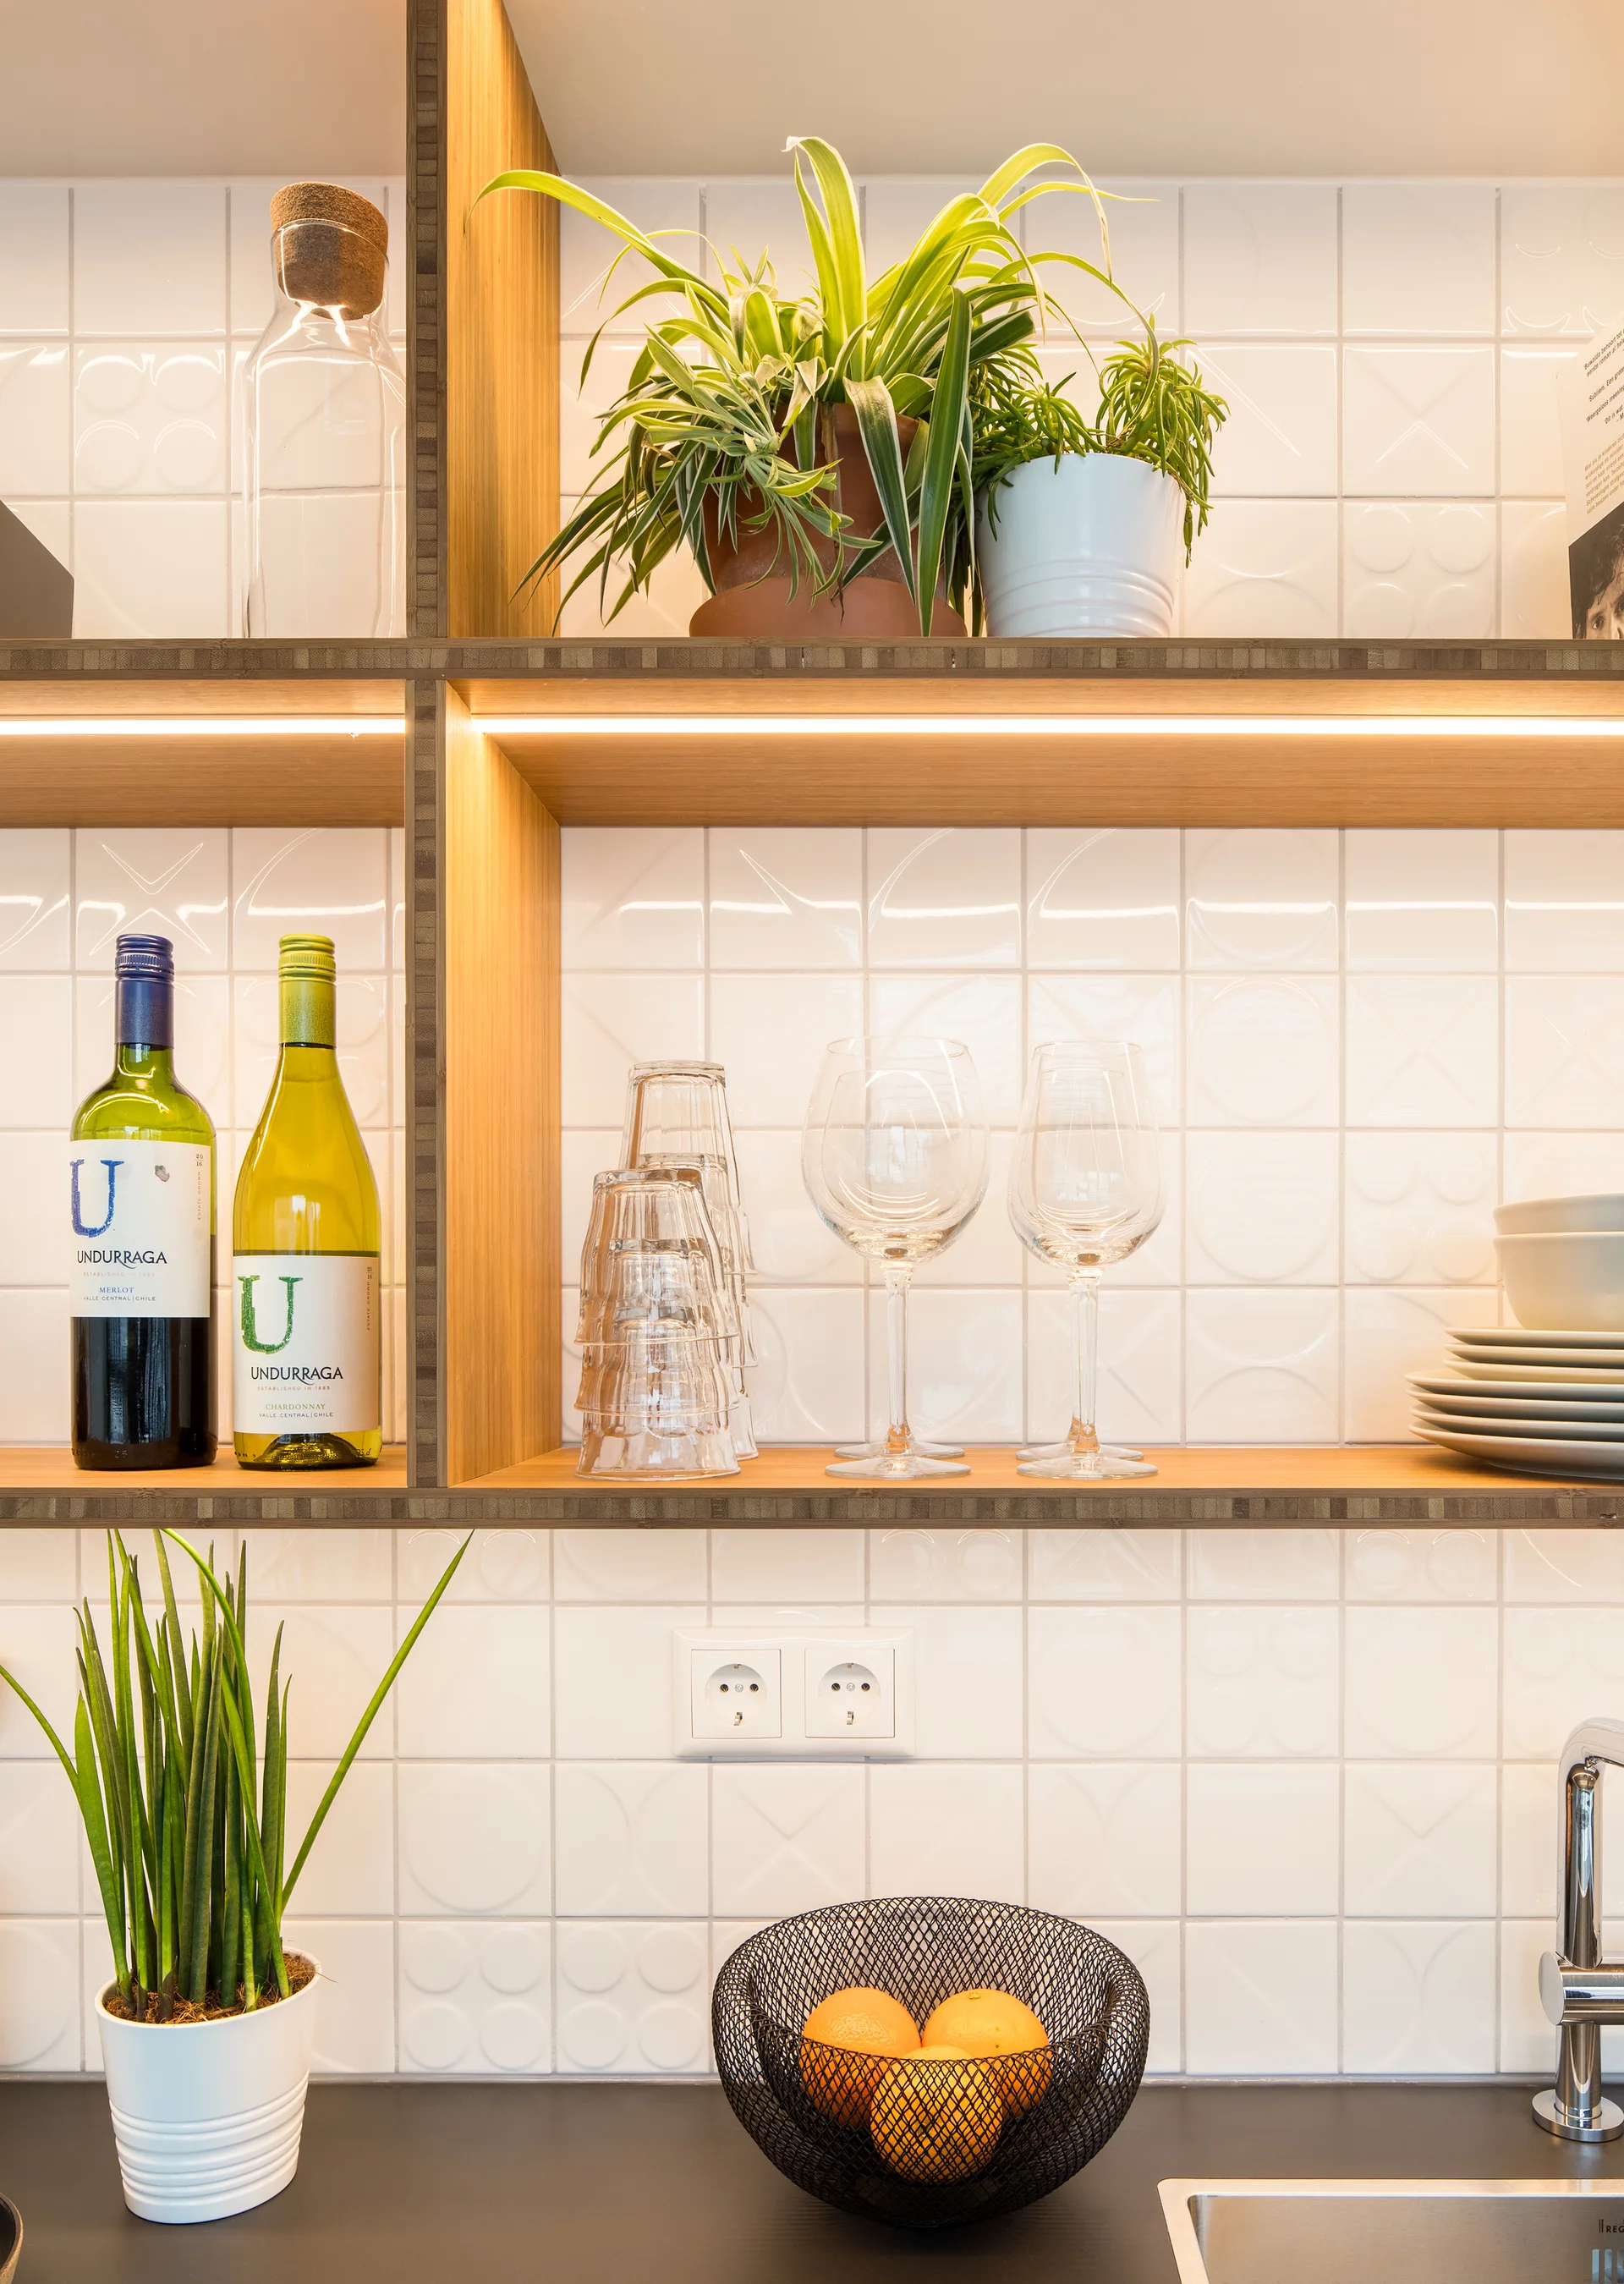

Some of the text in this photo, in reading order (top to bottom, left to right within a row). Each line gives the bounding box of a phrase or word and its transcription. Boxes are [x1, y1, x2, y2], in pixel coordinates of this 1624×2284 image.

[69, 1159, 125, 1238] U
[77, 1249, 167, 1270] UNDURRAGA
[238, 1275, 303, 1355] U
[250, 1366, 343, 1386] UNDURRAGA
